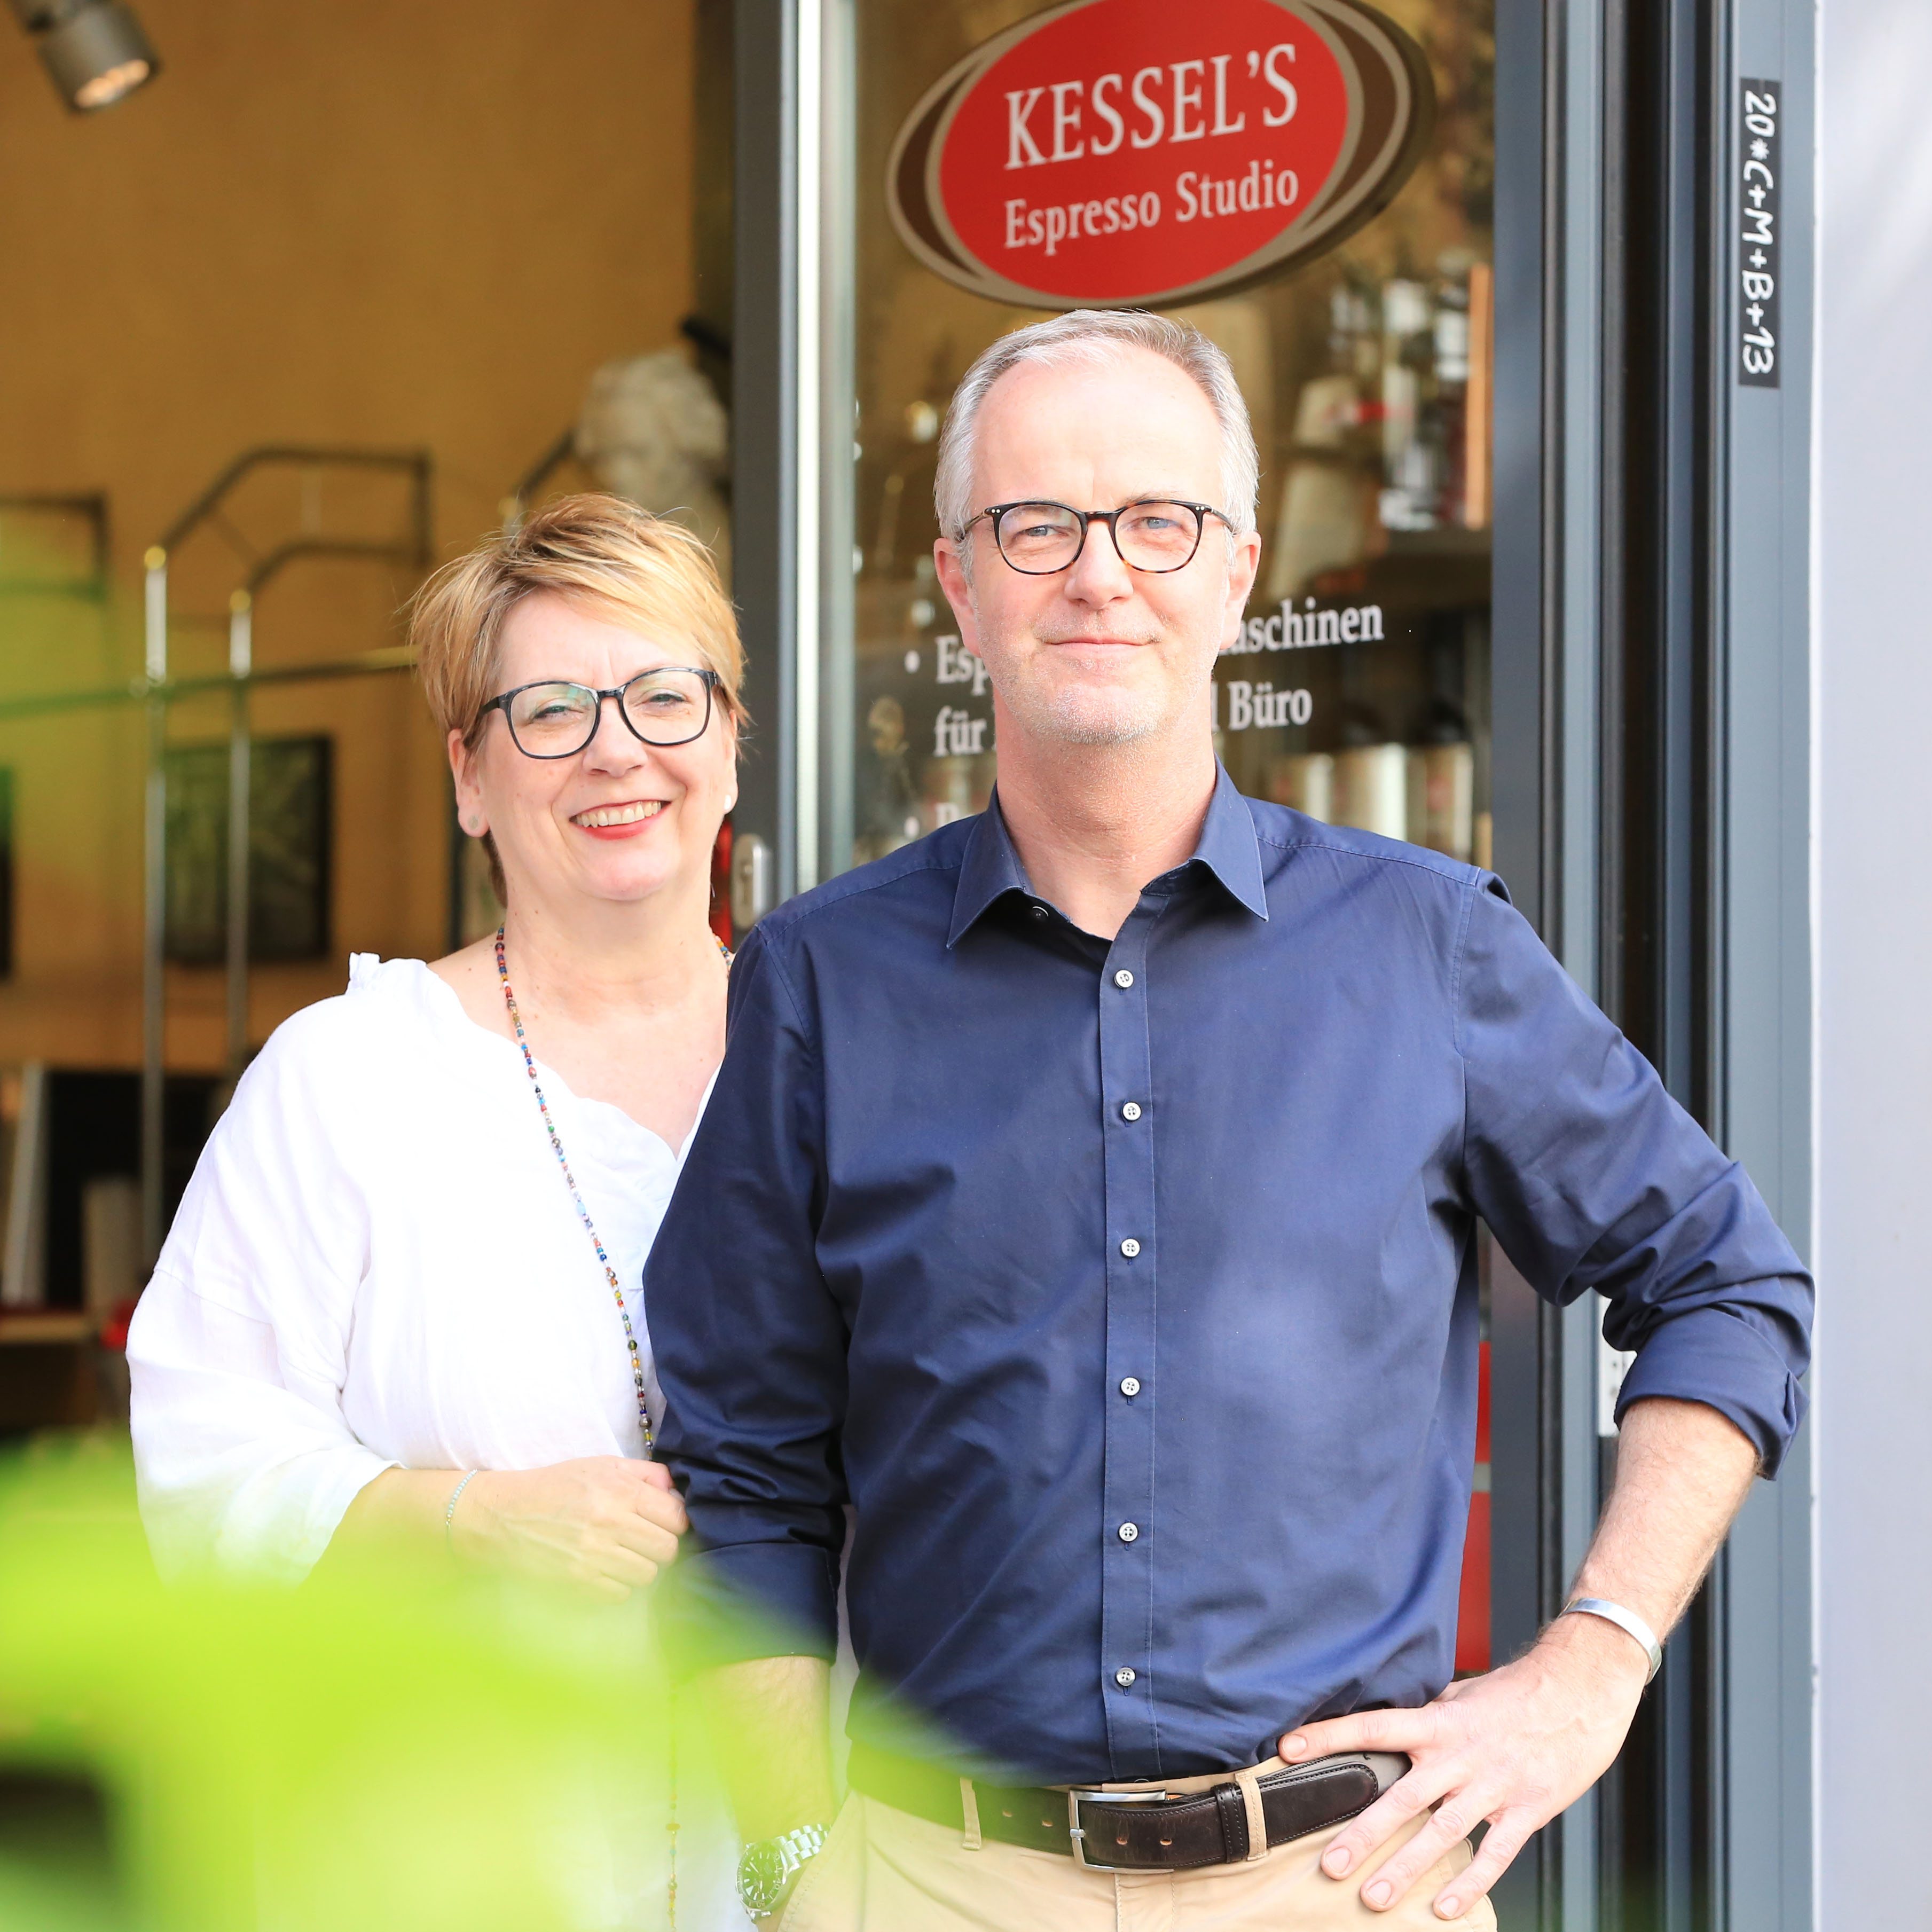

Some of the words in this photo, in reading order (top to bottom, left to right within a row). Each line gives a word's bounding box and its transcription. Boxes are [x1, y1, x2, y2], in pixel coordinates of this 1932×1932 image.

[1004, 43, 1298, 171] KESSEL'S
[1004, 191, 1161, 257] Espresso
[1175, 159, 1299, 223] Studio
[935, 633, 990, 697] Esp
[1219, 595, 1385, 656] aschinen
[933, 704, 987, 757] für
[1227, 680, 1313, 731] Büro
